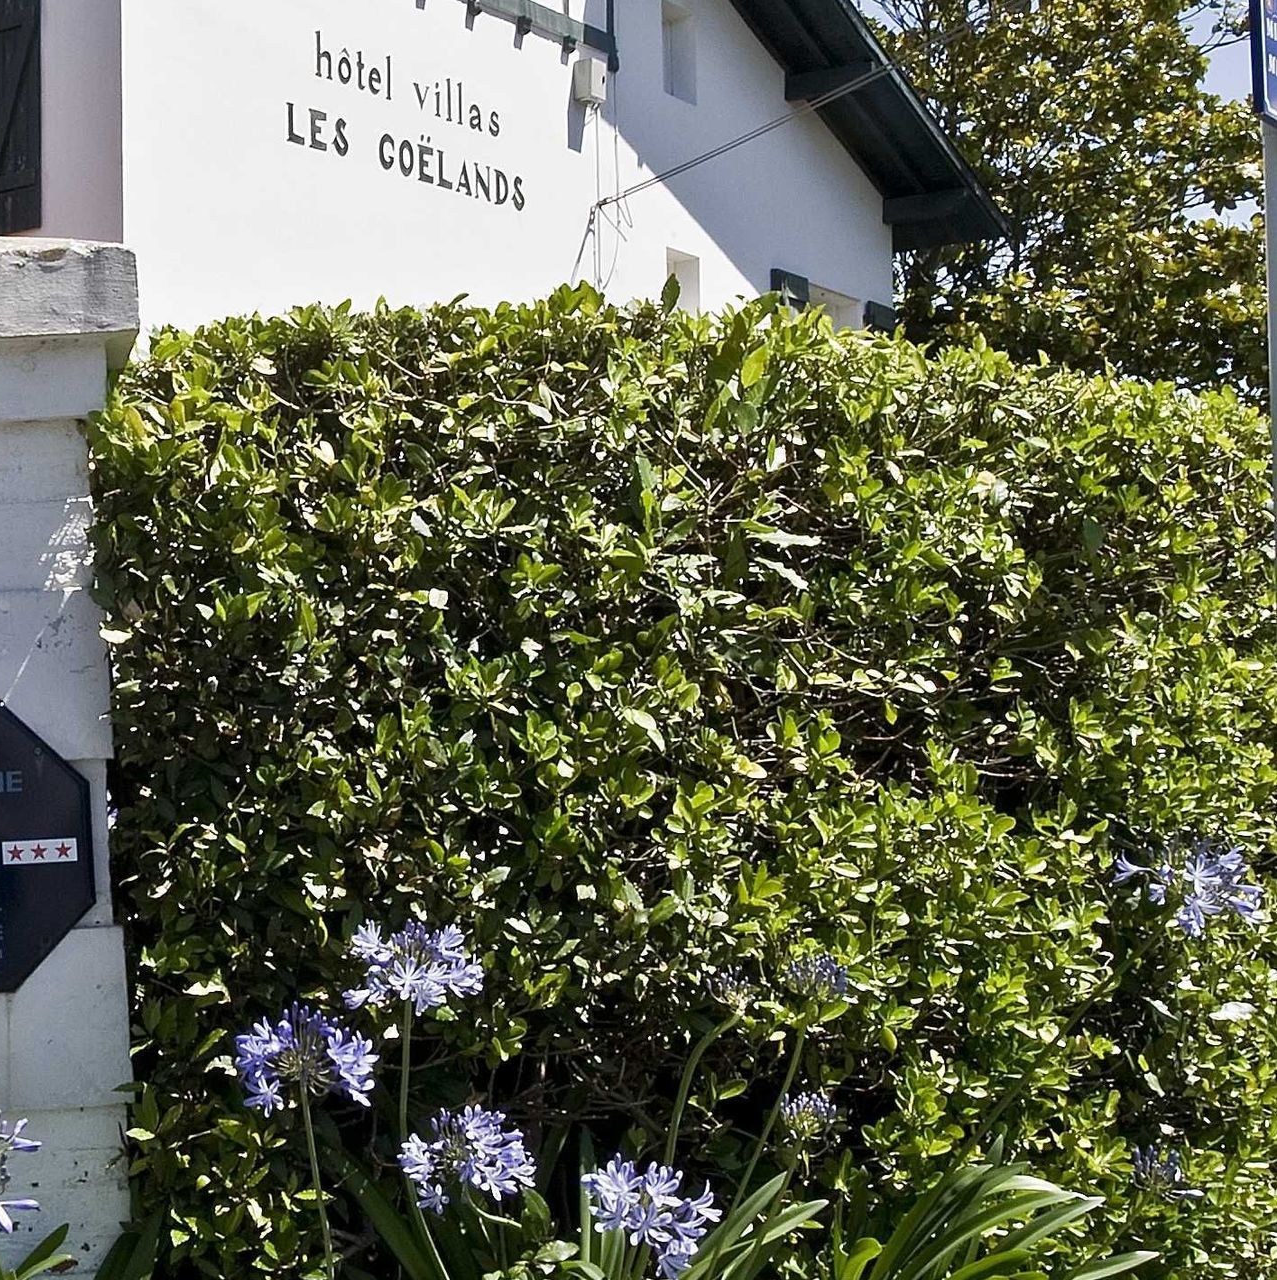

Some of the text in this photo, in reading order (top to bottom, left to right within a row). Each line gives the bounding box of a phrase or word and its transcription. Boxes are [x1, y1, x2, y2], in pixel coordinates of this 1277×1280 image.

[315, 30, 500, 137] hôtel villas
[286, 102, 525, 211] LES GOËLANDS
